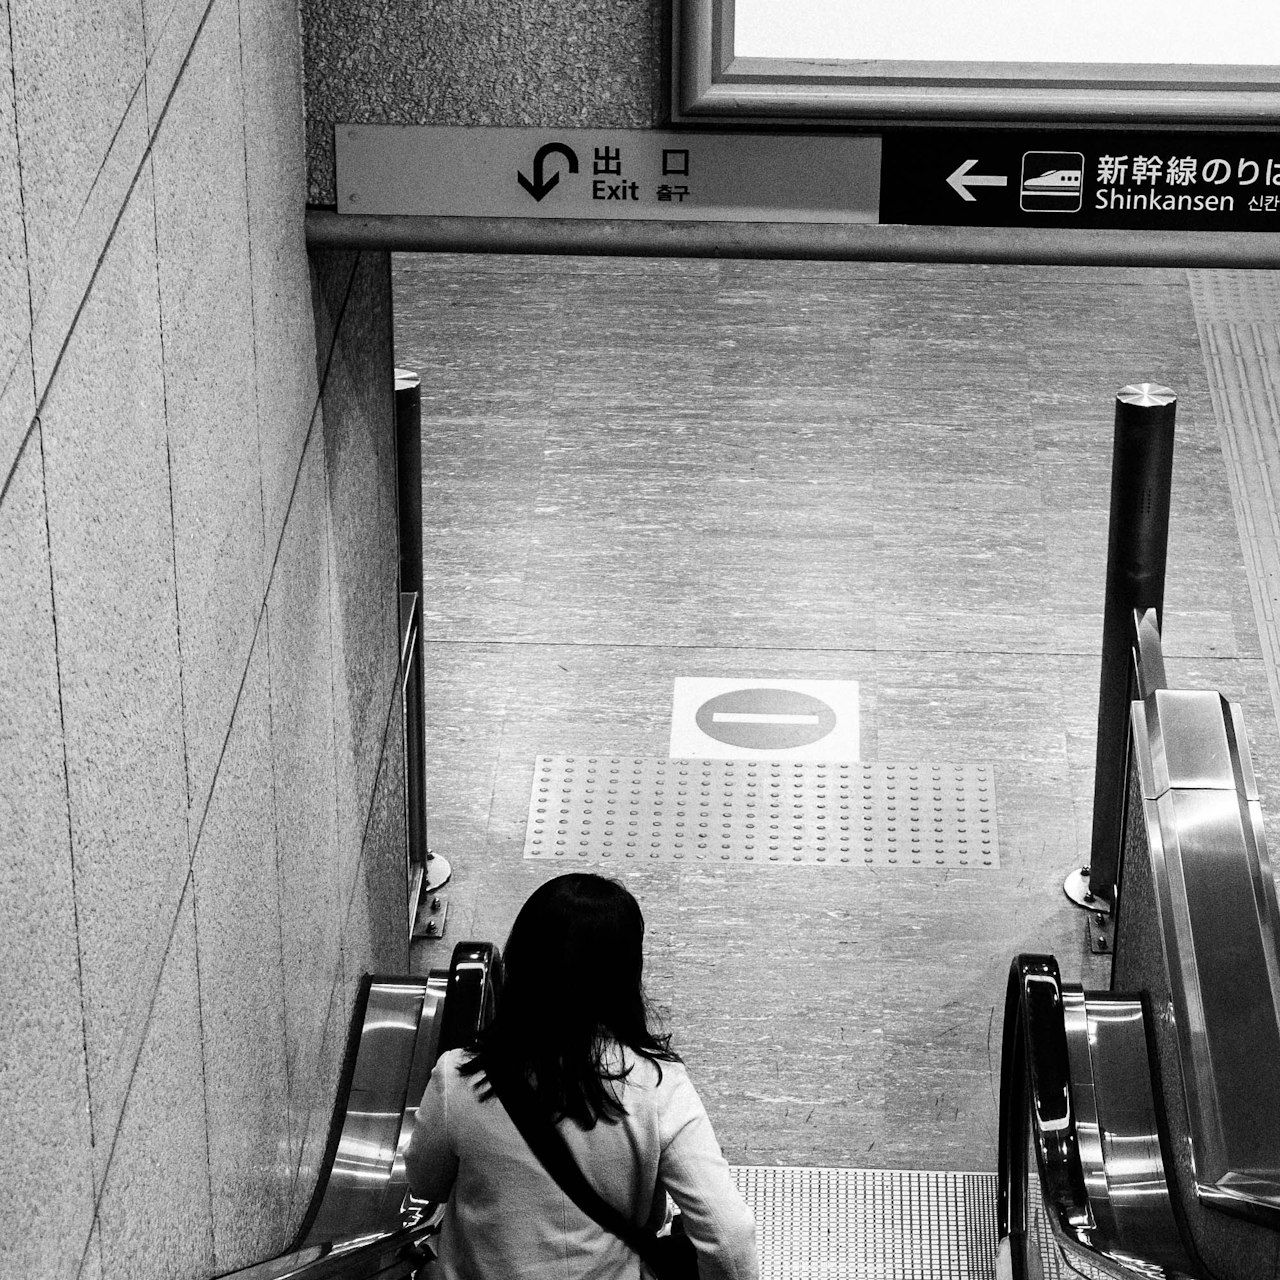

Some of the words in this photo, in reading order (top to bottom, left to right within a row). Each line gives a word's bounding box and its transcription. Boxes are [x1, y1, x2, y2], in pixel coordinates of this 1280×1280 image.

[593, 145, 690, 176] 出口
[592, 179, 640, 201] Exit
[656, 184, 690, 202] 출구
[1095, 188, 1235, 212] Shinkansen
